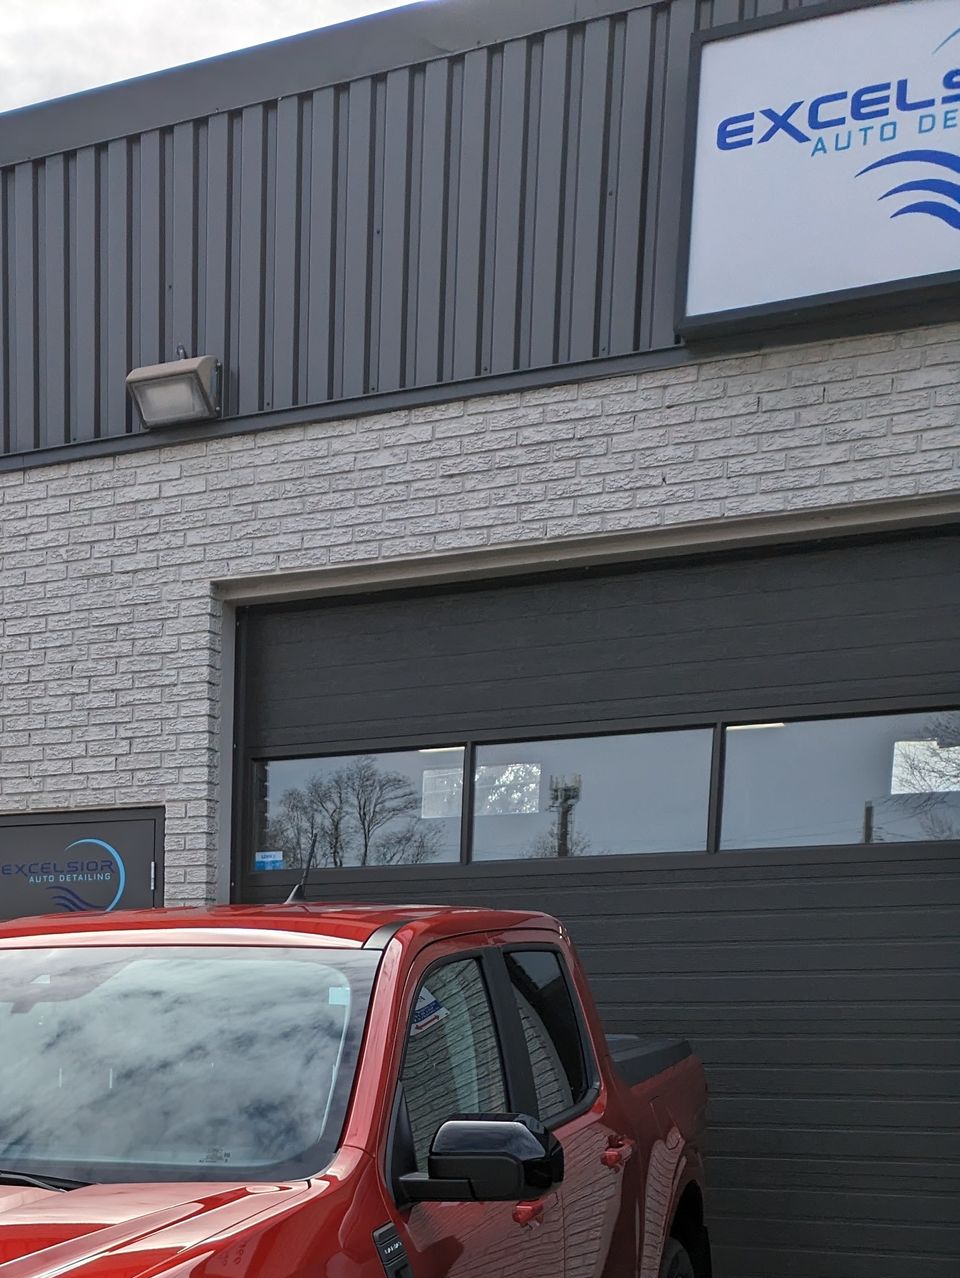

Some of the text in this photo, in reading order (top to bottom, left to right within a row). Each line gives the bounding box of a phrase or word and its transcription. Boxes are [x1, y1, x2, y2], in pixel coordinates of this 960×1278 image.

[811, 121, 897, 157] AUTO
[1, 859, 115, 877] EXCELSIOR
[28, 872, 111, 883] AUTO DETAILING
